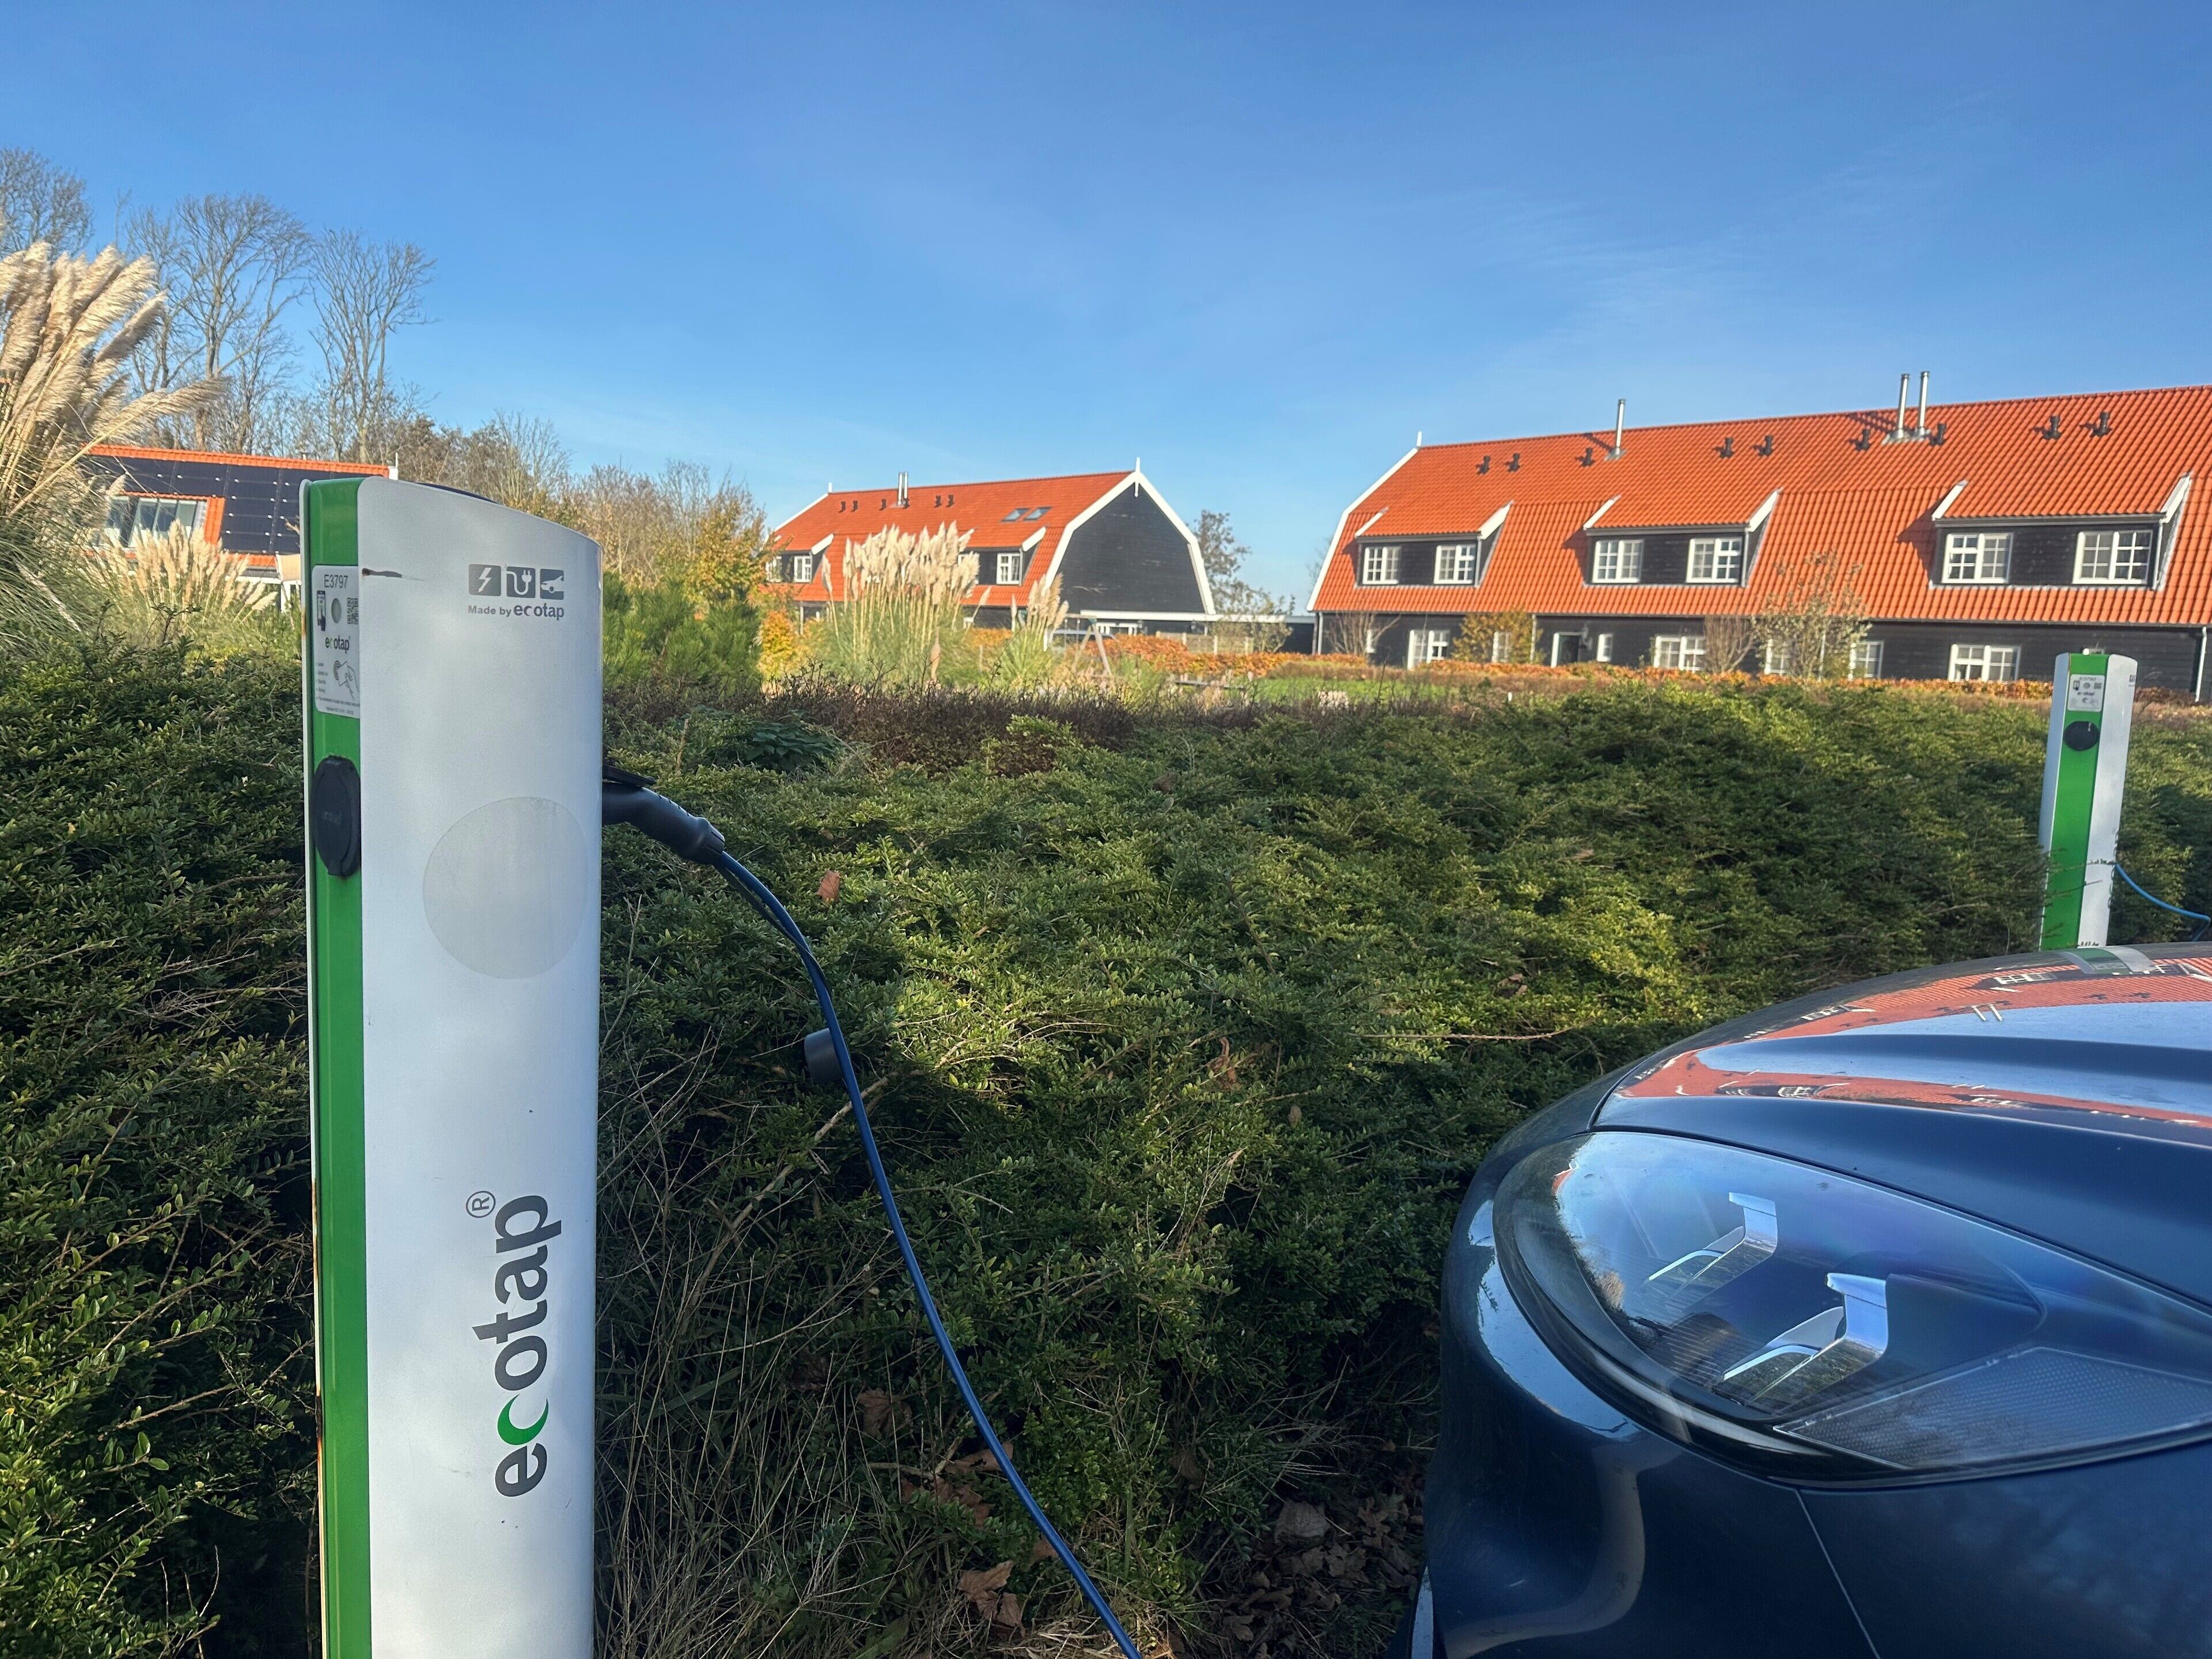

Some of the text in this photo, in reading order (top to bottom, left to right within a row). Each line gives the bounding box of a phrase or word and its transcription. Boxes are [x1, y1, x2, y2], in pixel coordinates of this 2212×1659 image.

[324, 574, 348, 588] E3797
[468, 603, 565, 620] Made by ecotap
